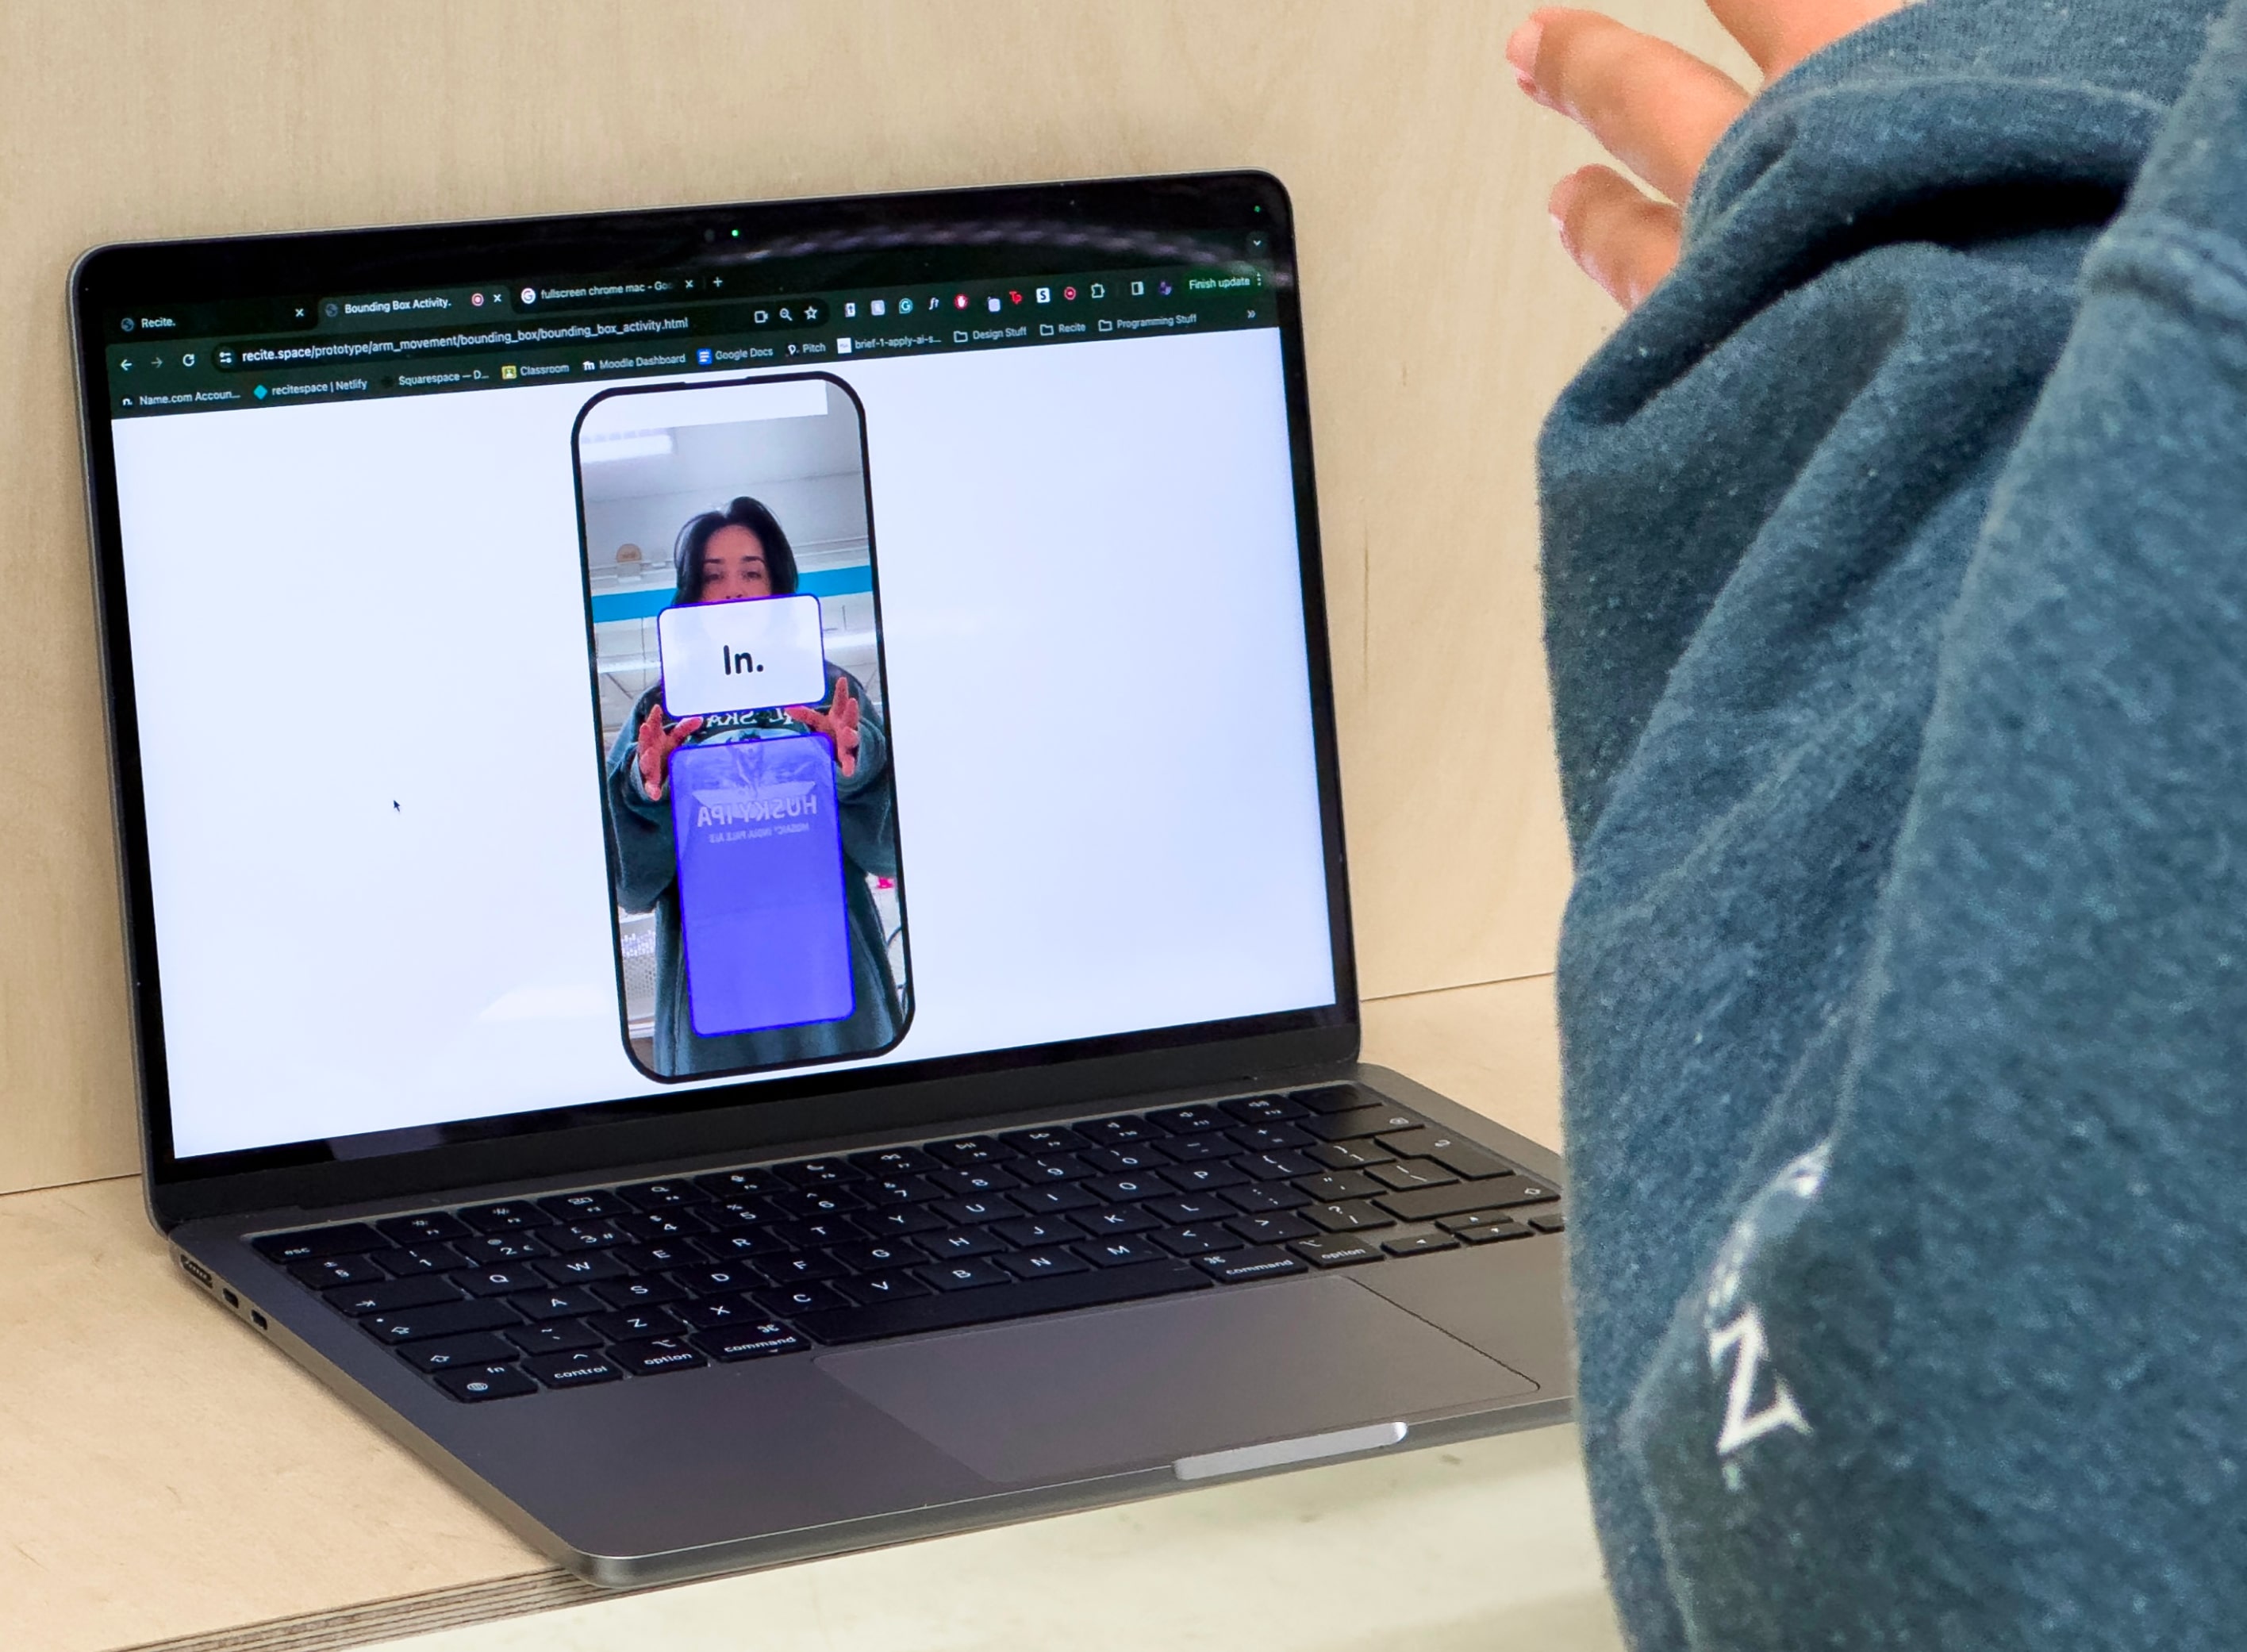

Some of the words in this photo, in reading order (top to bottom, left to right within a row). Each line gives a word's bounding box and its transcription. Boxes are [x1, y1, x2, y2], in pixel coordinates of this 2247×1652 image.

[1189, 278, 1217, 290] Finish
[1217, 276, 1250, 289] update
[540, 288, 587, 300] fullscreen
[588, 285, 624, 295] chrome
[624, 283, 646, 293] mac
[344, 301, 391, 314] Bounding
[392, 300, 412, 311] Box
[412, 297, 452, 309] Activity.
[140, 317, 176, 328] Recite.
[1116, 317, 1175, 330] Programming
[1175, 313, 1197, 325] Stuff
[972, 329, 1004, 340] Design
[1004, 326, 1027, 338] Stuff
[1058, 323, 1086, 333] Recite
[802, 342, 827, 354] Pitch
[714, 348, 748, 361] Google
[749, 348, 774, 358] Docs
[599, 358, 635, 370] Moodle
[635, 353, 686, 367] Dashboard
[520, 364, 570, 377] Classroom
[398, 373, 461, 386] Squarespace
[271, 383, 328, 396] recitespace
[335, 378, 368, 391] Netlify
[139, 394, 194, 405] Name.com
[723, 644, 764, 676] In.
[889, 1215, 905, 1224] Y
[1104, 1214, 1124, 1224] K
[811, 1226, 826, 1235] T
[732, 1238, 751, 1247] R
[948, 1237, 970, 1247] H
[652, 1250, 670, 1259] E
[1107, 1245, 1131, 1255] M
[1320, 1247, 1366, 1260] option
[567, 1262, 591, 1271] W
[793, 1260, 807, 1270] F
[1030, 1257, 1052, 1267] N
[1225, 1258, 1295, 1276] command
[711, 1273, 730, 1282] D
[952, 1270, 971, 1279] B
[630, 1285, 649, 1294] S
[871, 1281, 889, 1290] V
[551, 1298, 567, 1308] A
[793, 1293, 812, 1303] C
[709, 1305, 731, 1316] X
[627, 1318, 647, 1328] Z
[724, 1335, 797, 1353] command
[643, 1353, 693, 1365] option
[554, 1365, 608, 1379] control
